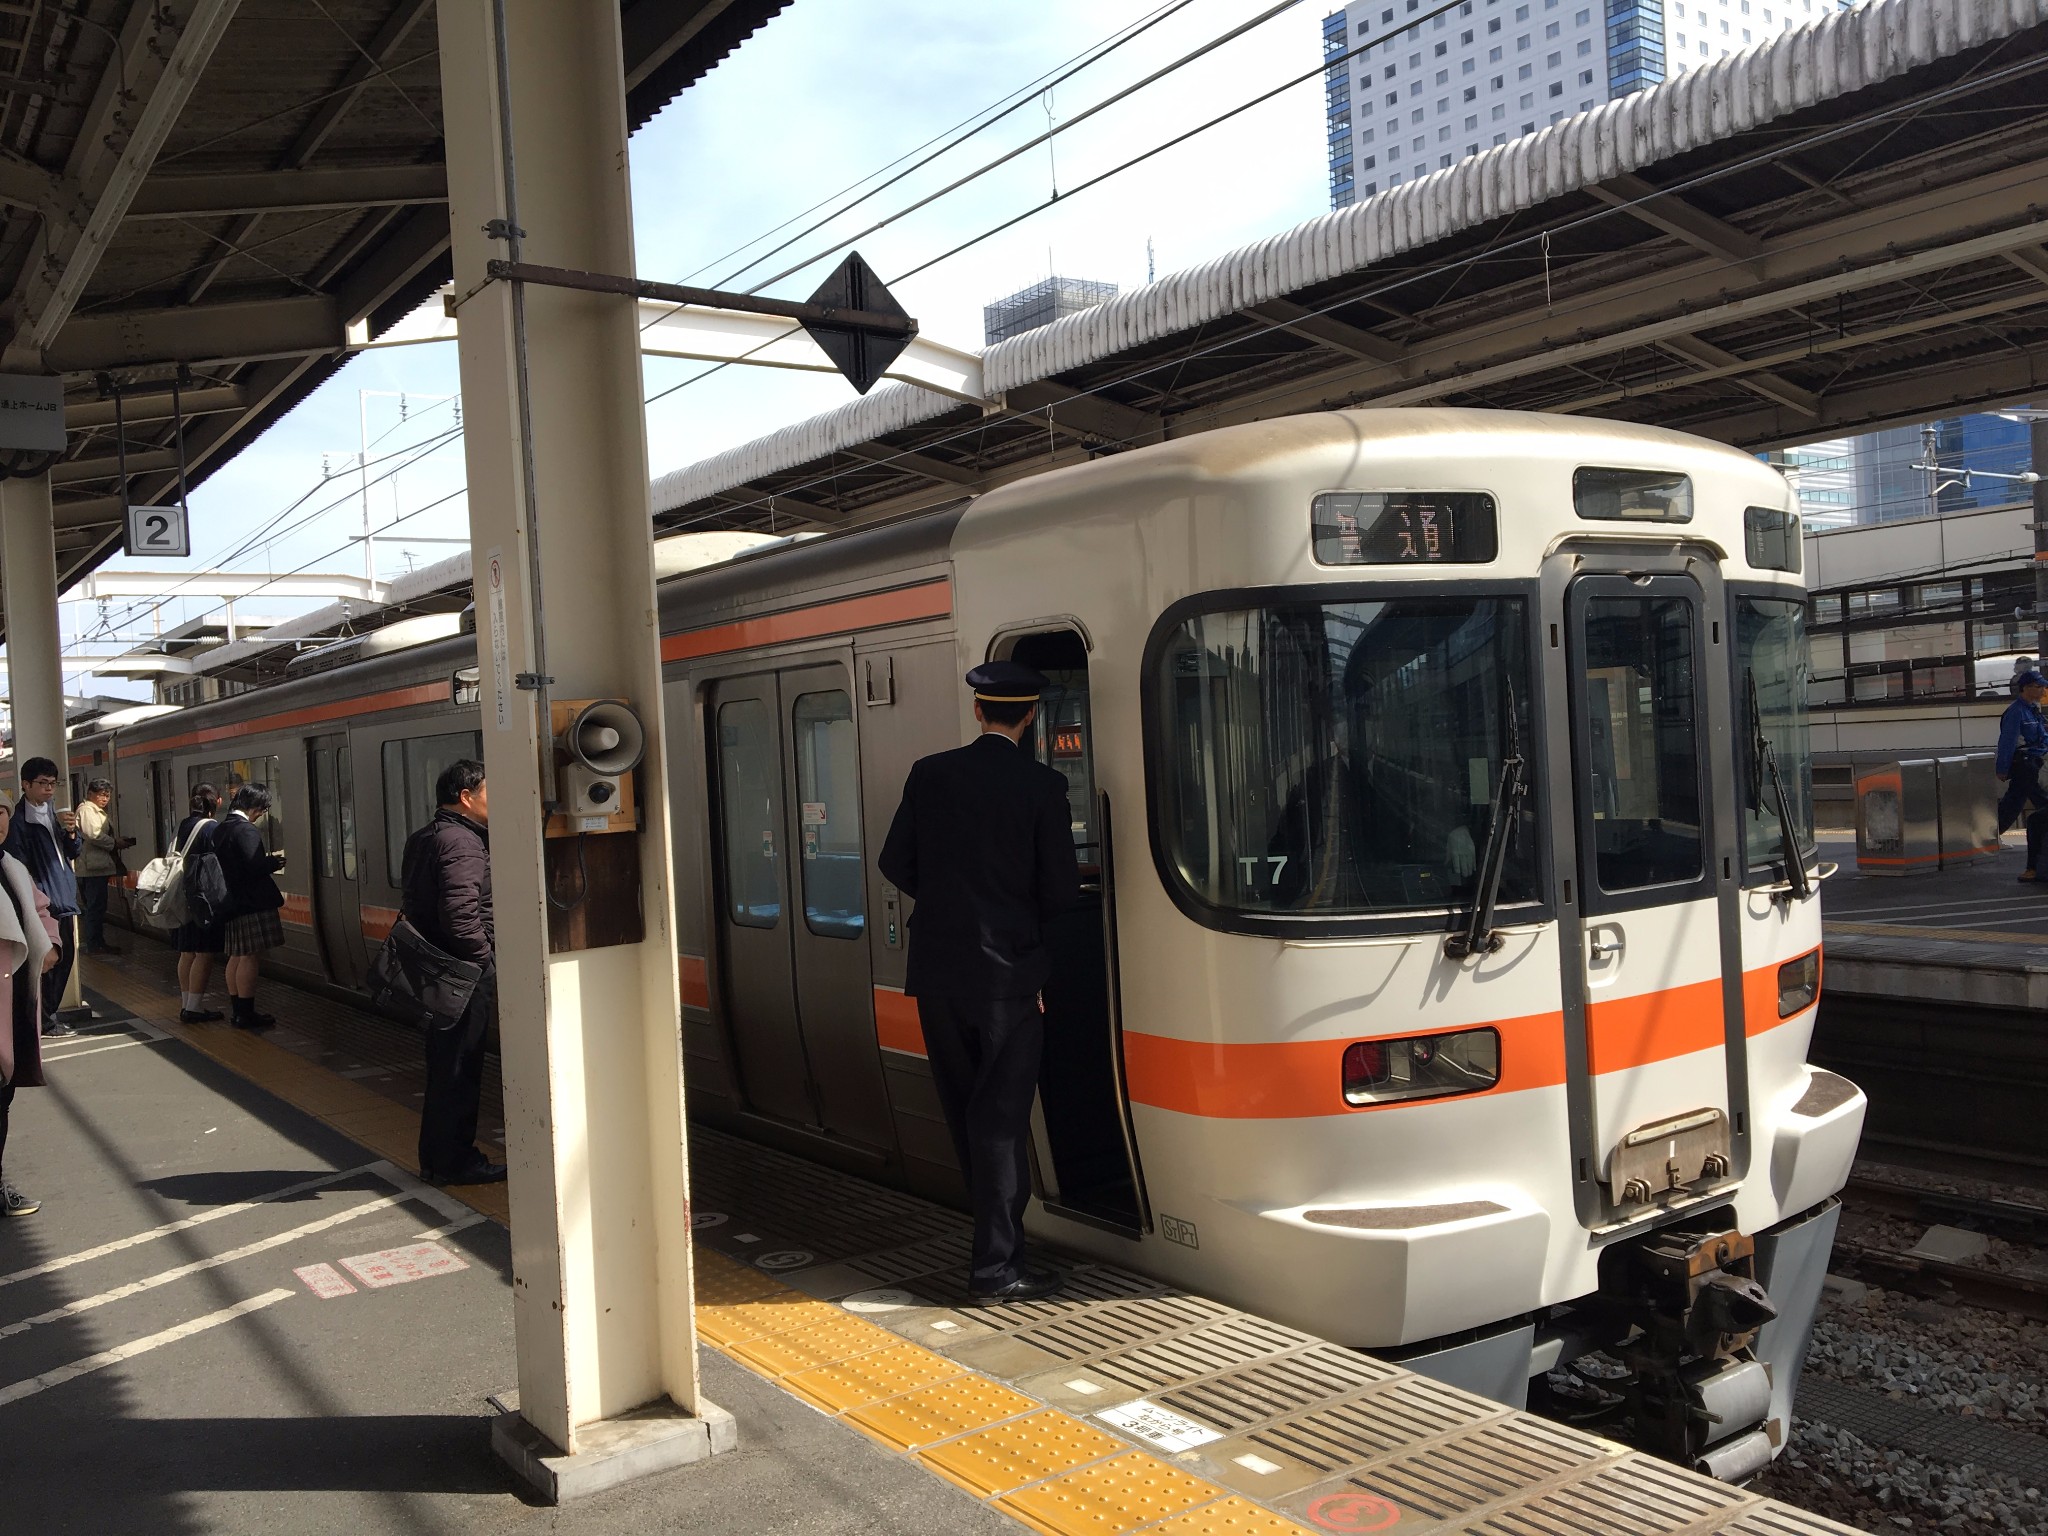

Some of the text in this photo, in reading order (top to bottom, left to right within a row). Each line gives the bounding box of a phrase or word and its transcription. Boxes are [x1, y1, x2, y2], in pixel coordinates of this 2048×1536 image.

[145, 515, 171, 545] 2
[1122, 1420, 1165, 1441] 3号車
[1139, 1414, 1186, 1435] ながら号
[1143, 1407, 1204, 1435] ムーンライト
